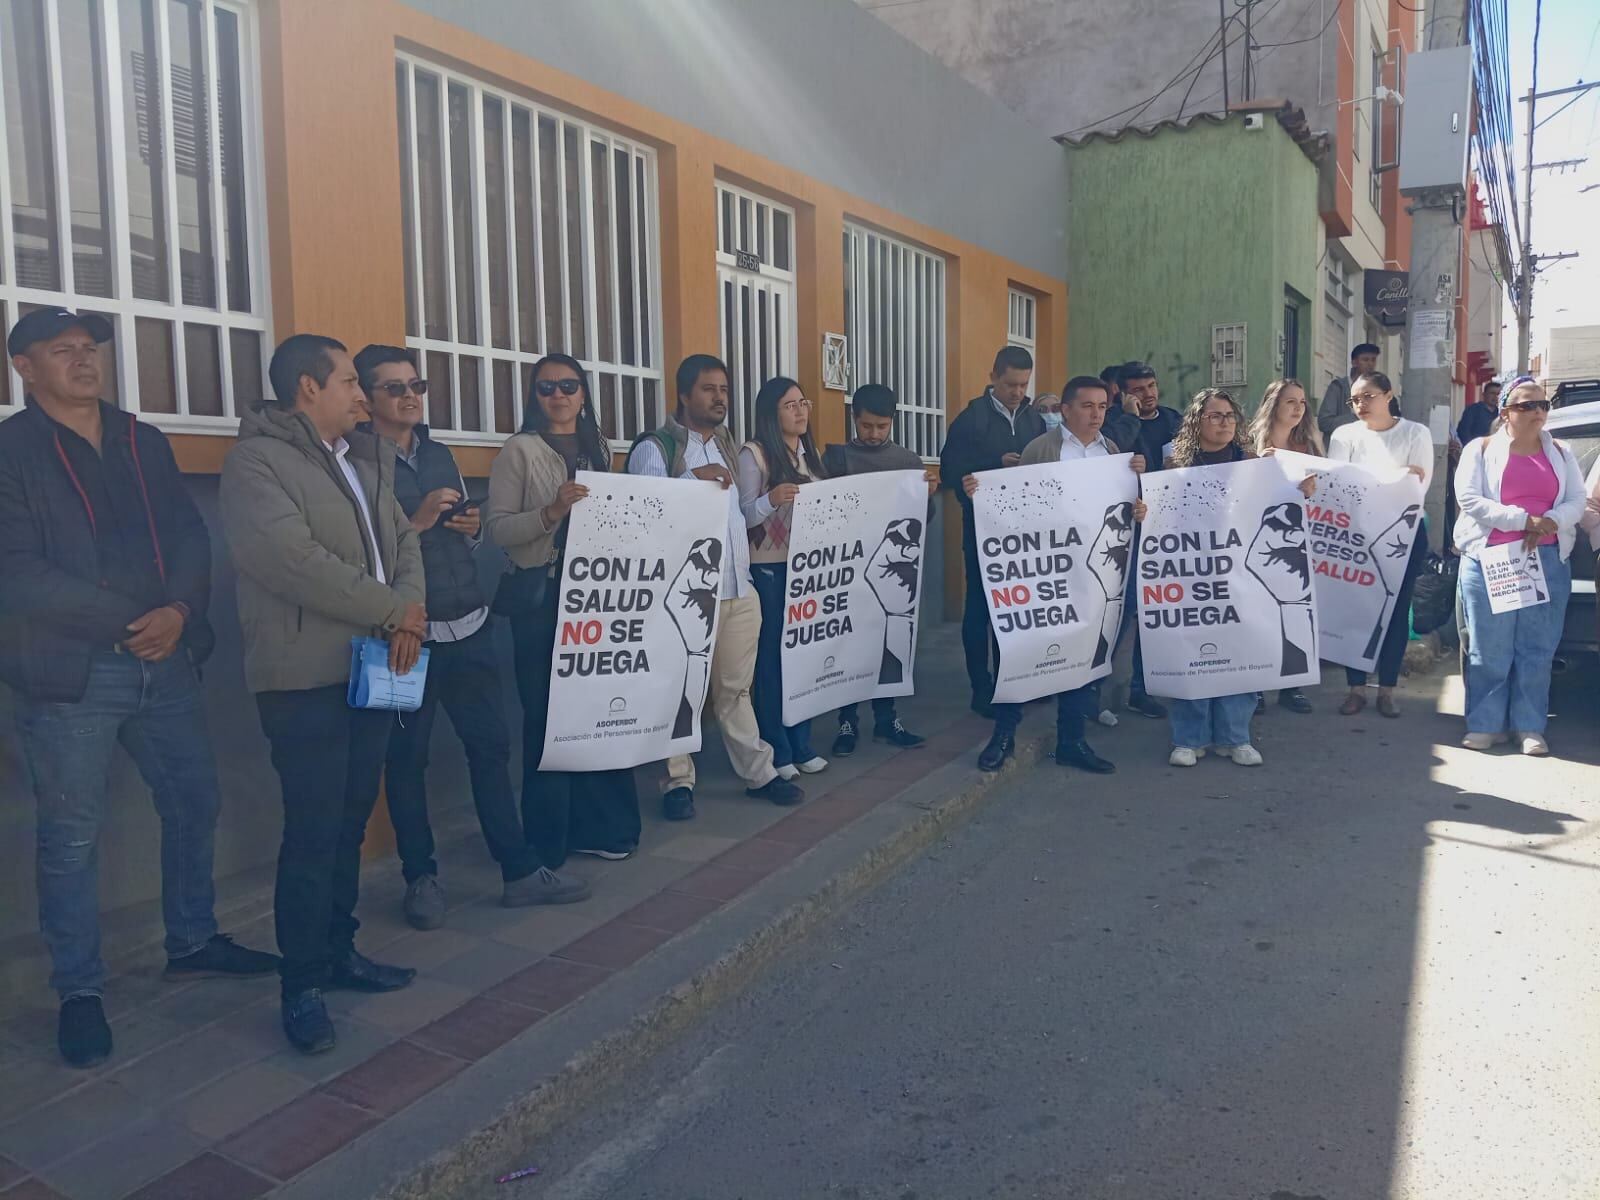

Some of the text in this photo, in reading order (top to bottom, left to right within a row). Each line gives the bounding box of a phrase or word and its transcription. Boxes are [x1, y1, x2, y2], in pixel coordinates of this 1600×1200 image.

[1305, 504, 1351, 529] MAS
[982, 527, 1083, 557] CON LA
[1141, 528, 1243, 555] CON LA
[1308, 522, 1366, 548] ERAS
[791, 540, 864, 573] CON LA
[1310, 540, 1369, 565] CESO
[1496, 558, 1521, 567] SALUD
[569, 557, 665, 581] CON LA
[986, 553, 1073, 583] SALUD
[1140, 555, 1233, 579] SALUD
[1488, 569, 1523, 581] DERECHO
[789, 566, 855, 598] SALUD
[991, 579, 1068, 609] NO SE
[1143, 581, 1230, 605] NO SE
[565, 589, 653, 613] SALUD
[788, 592, 849, 624] NO SE
[997, 604, 1079, 634] JUEGA
[1144, 605, 1241, 630] JUEGA
[561, 620, 643, 645] NO SE
[784, 616, 853, 649] JUEGA
[557, 650, 650, 678] JUEGA
[595, 718, 638, 728] ASOPERBOY
